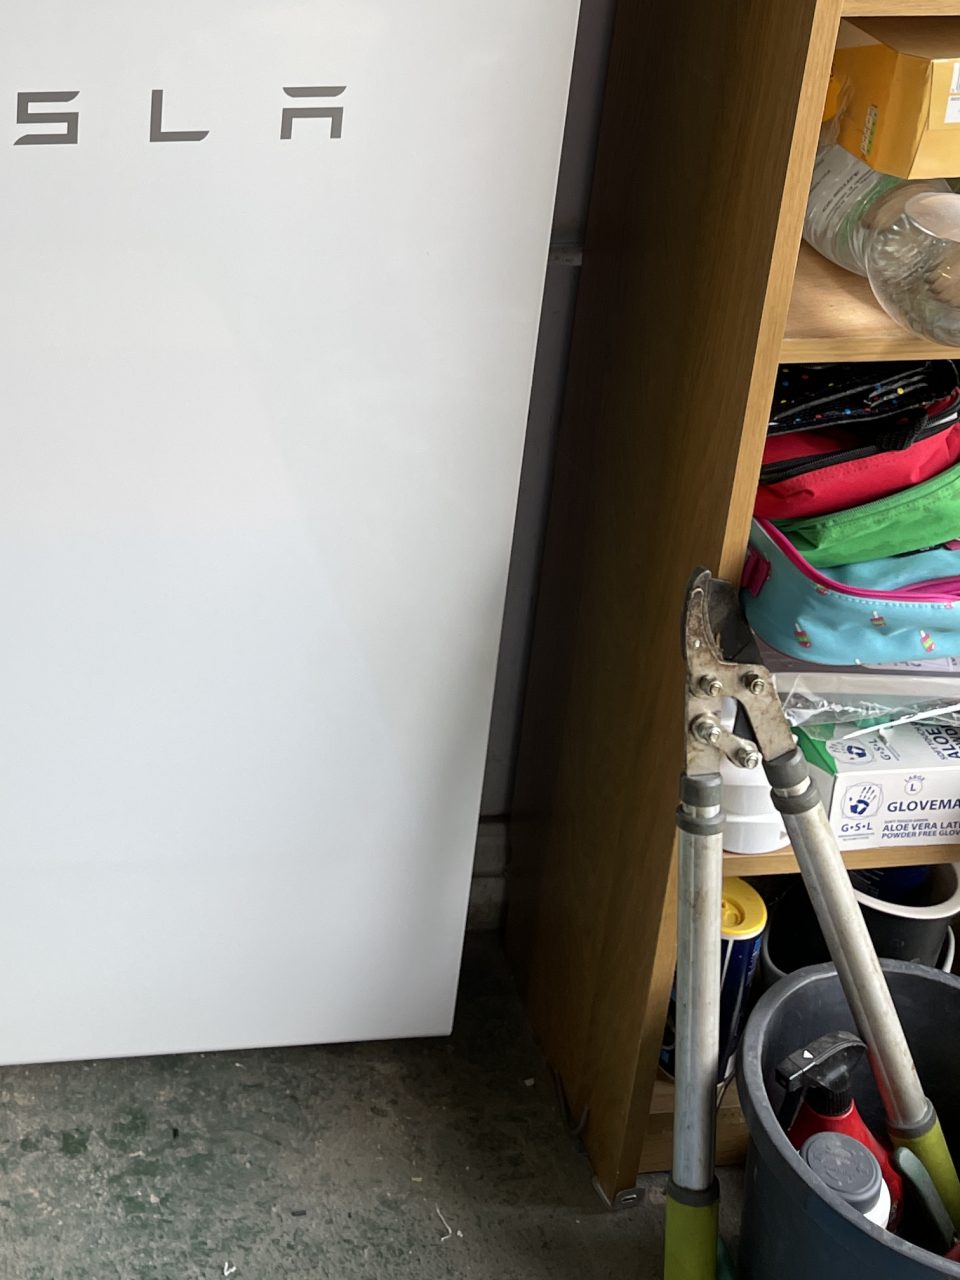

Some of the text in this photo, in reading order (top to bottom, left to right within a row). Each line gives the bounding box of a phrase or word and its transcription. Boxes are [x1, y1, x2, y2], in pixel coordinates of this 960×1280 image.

[910, 783, 916, 792] L
[882, 822, 910, 832] ALOE
[911, 822, 938, 830] VERA
[882, 831, 917, 839] POWDER
[918, 830, 937, 838] FREE
